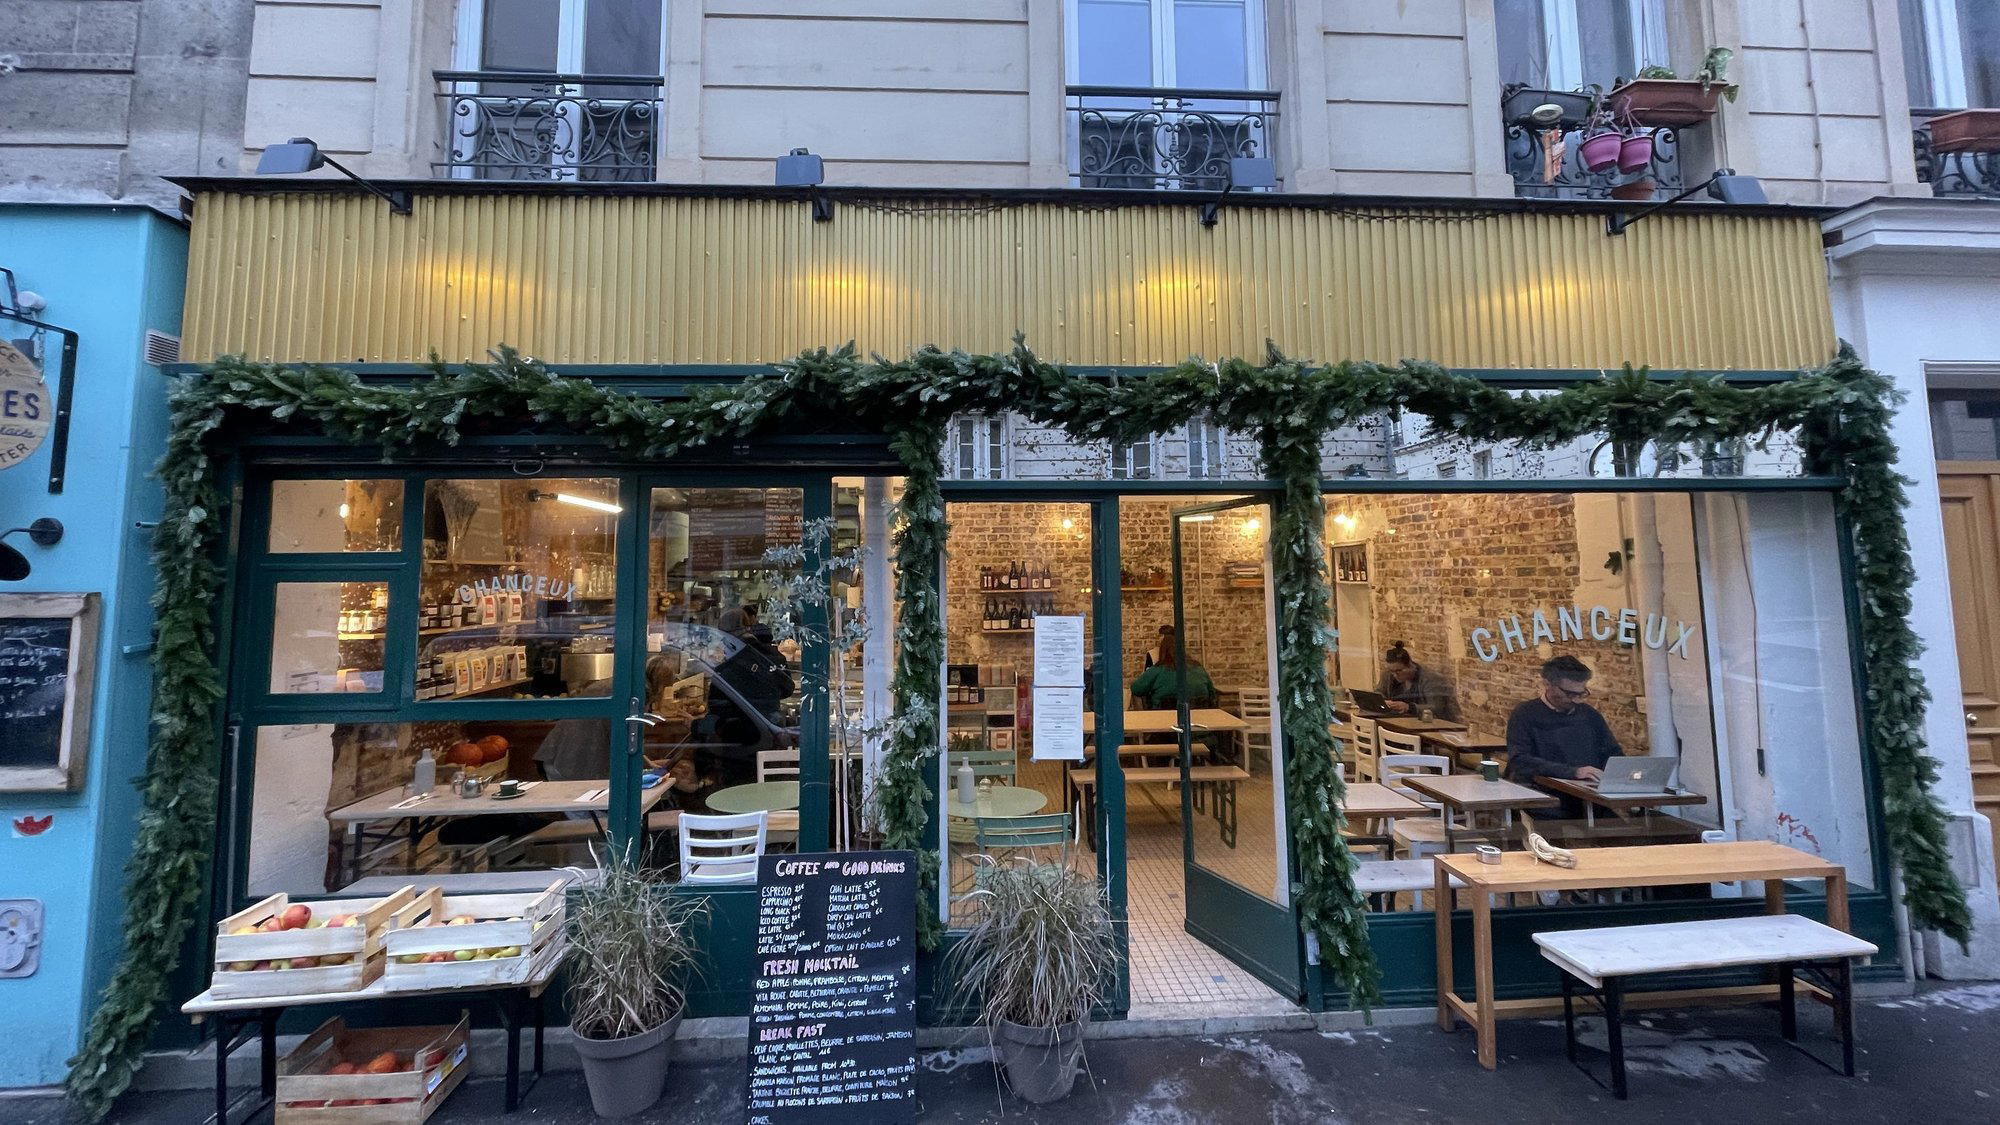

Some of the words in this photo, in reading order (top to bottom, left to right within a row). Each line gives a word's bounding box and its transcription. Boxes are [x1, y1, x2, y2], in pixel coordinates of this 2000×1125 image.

[459, 573, 577, 603] CHANCEUX
[1471, 604, 1696, 663] CHANCEUX
[775, 859, 821, 877] COFFEE
[842, 861, 869, 876] GOOD
[762, 886, 792, 897] ESPRESSO
[845, 885, 862, 893] LATTE
[771, 916, 789, 924] COFFEE
[768, 926, 782, 934] LATTE
[763, 959, 799, 976] FRESH
[756, 979, 770, 989] RED
[871, 974, 895, 982] MENTHE
[760, 1027, 793, 1041] BREAK
[797, 1023, 827, 1039] FAST
[821, 1061, 837, 1070] FROM
